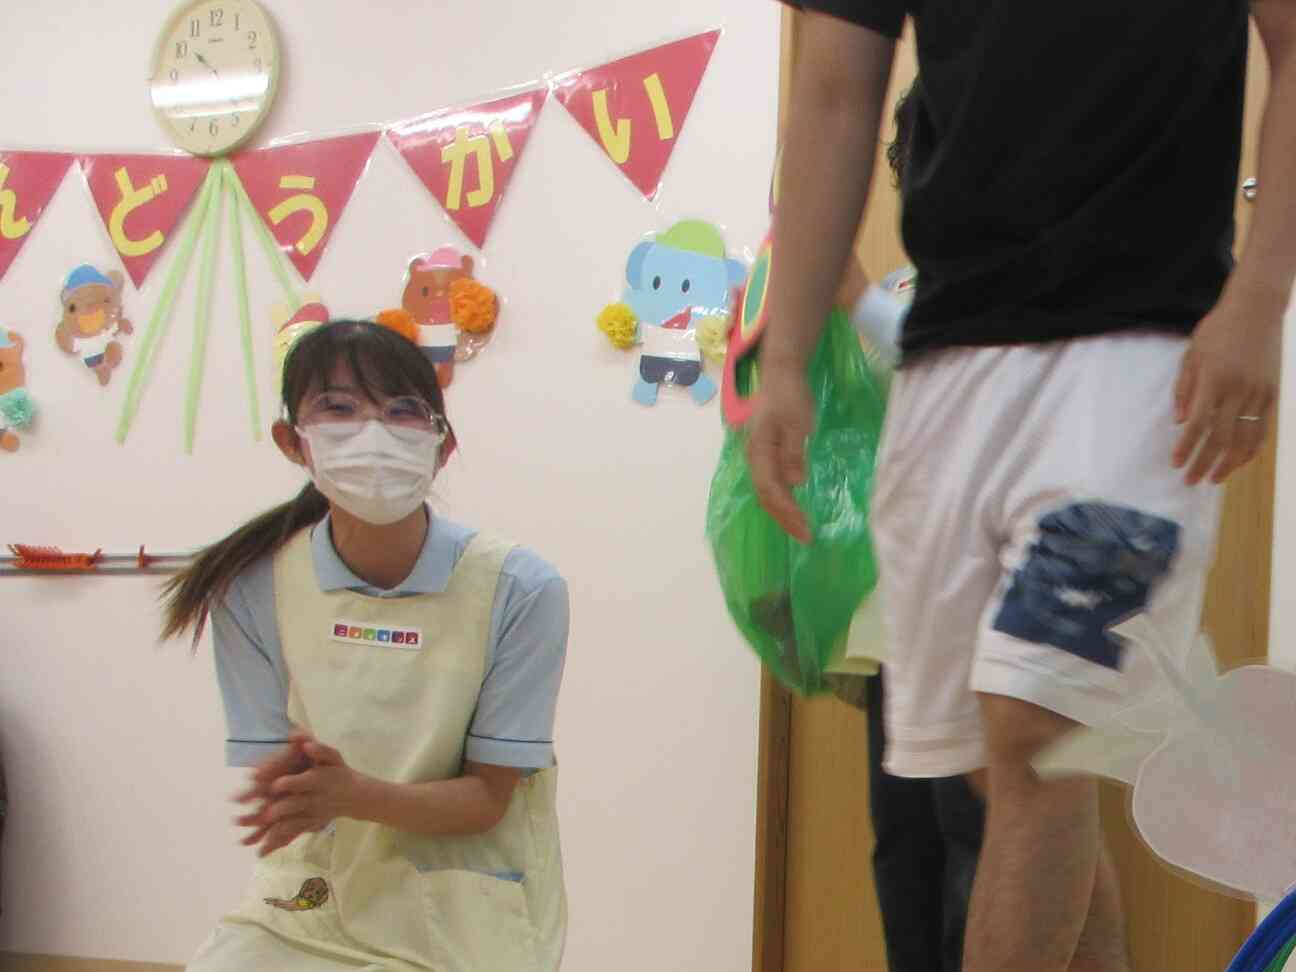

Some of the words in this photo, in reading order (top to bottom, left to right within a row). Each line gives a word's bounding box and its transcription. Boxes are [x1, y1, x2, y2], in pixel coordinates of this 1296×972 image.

[210, 9, 224, 26] 12
[190, 19, 200, 37] 11
[176, 40, 188, 58] 10
[248, 31, 257, 49] 2
[209, 118, 218, 136] 6
